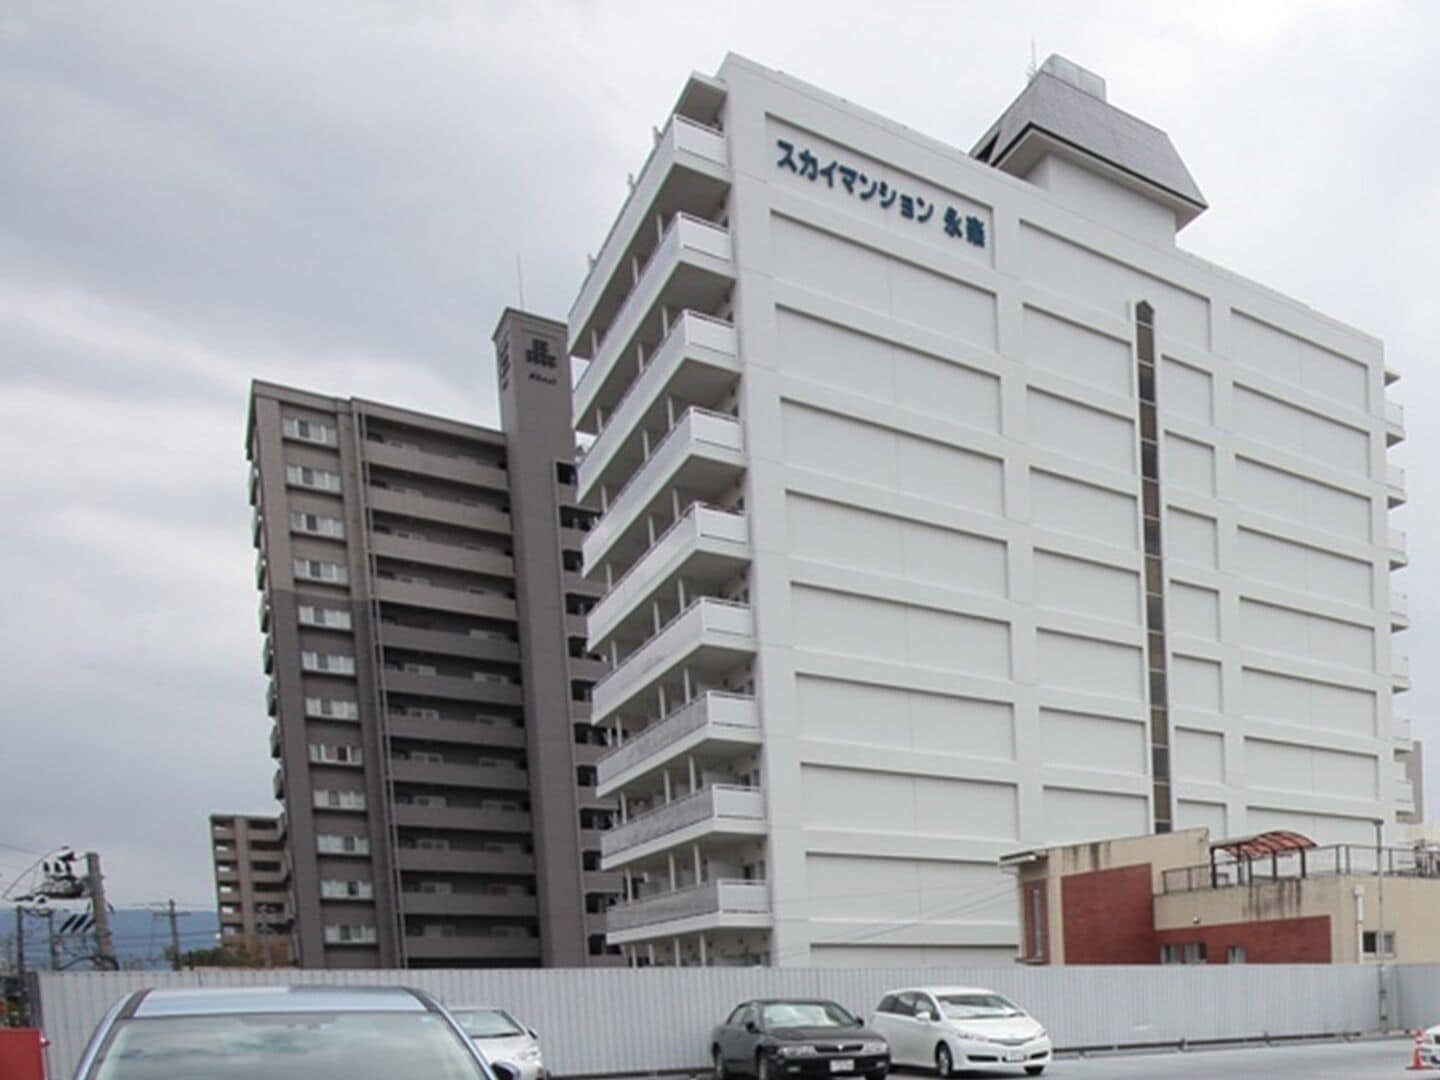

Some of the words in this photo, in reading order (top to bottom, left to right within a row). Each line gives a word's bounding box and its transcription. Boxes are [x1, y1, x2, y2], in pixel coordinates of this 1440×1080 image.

[776, 139, 934, 223] スカイマンション
